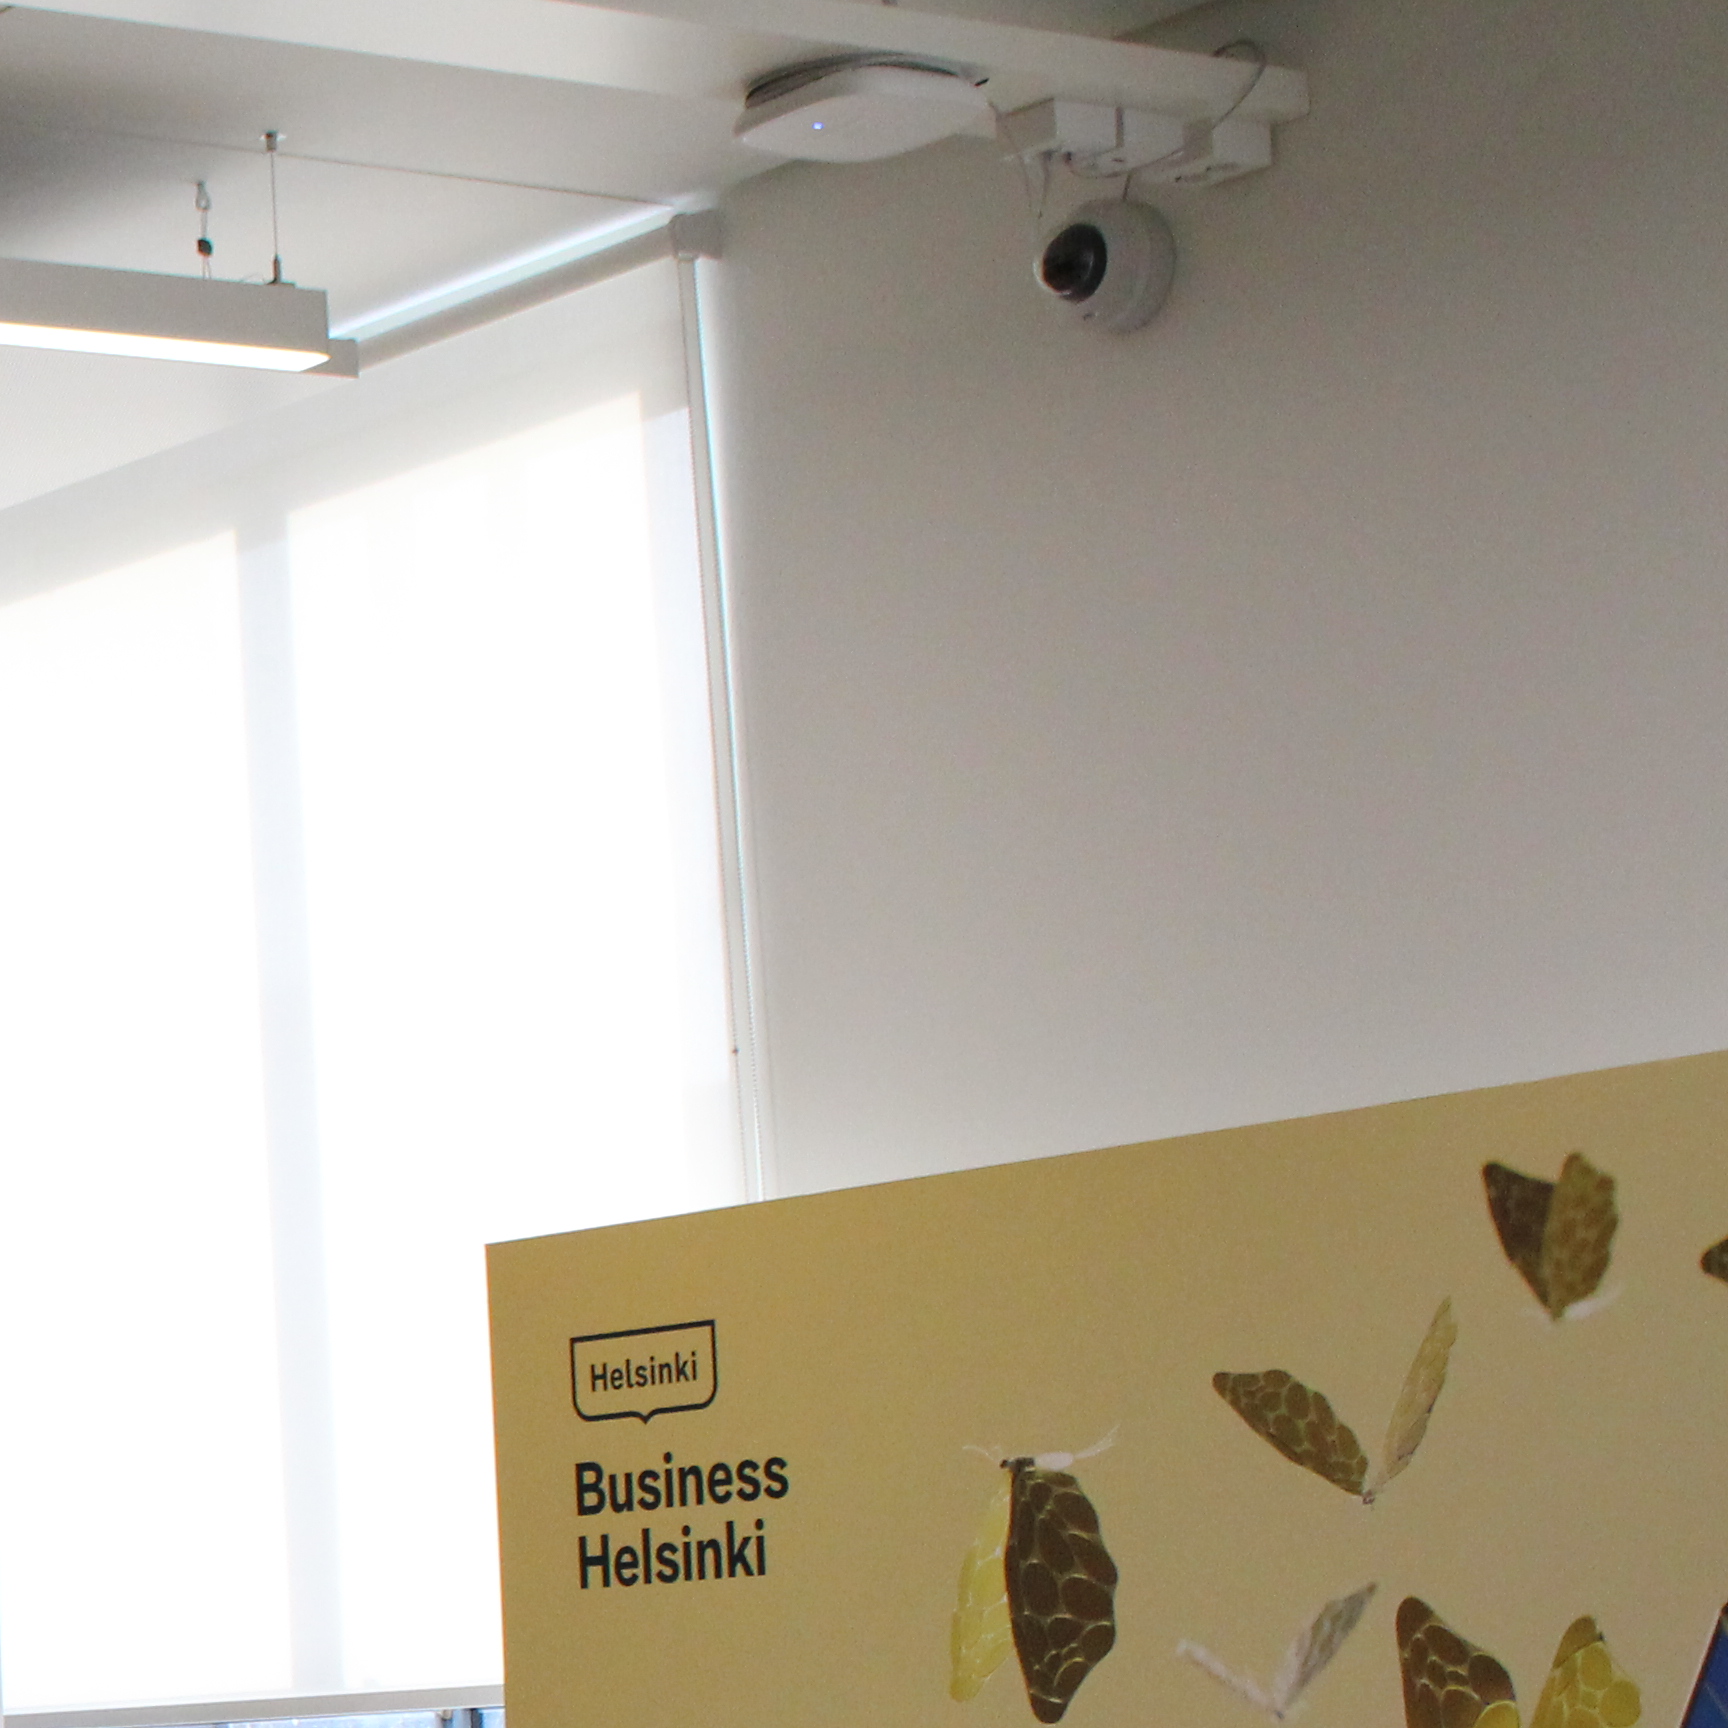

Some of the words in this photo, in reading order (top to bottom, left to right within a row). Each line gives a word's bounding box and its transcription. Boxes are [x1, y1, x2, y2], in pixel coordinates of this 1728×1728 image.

[589, 1350, 699, 1393] Helsinki
[574, 1451, 790, 1516] Business
[577, 1518, 768, 1590] Helsinki
